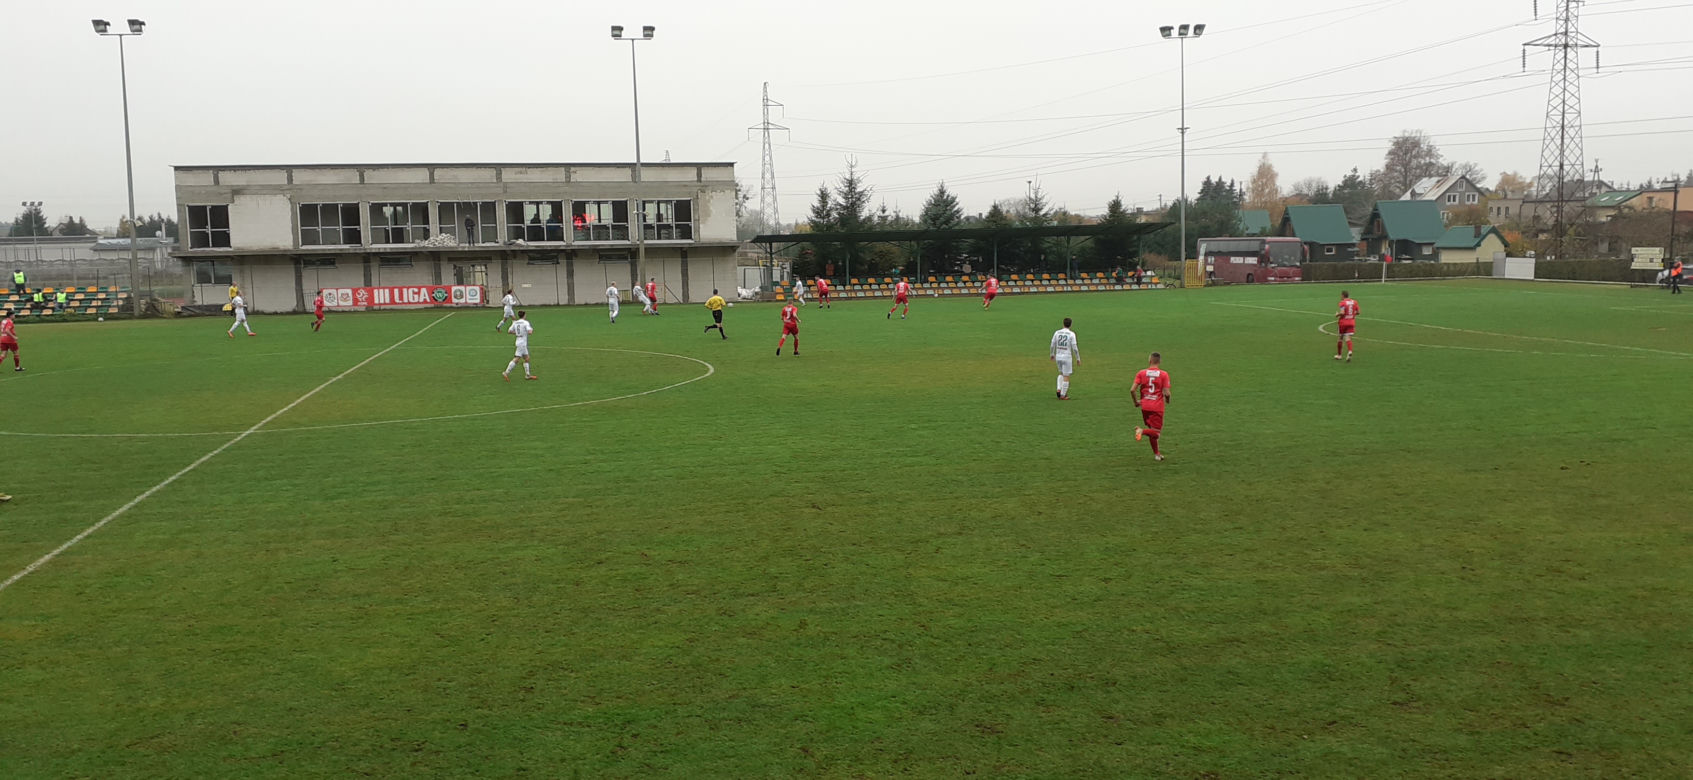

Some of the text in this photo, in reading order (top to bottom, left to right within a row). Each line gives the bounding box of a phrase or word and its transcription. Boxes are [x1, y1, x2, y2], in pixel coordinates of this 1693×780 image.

[373, 287, 431, 304] III LIGA
[1057, 334, 1068, 346] 22
[1149, 377, 1155, 393] 5
